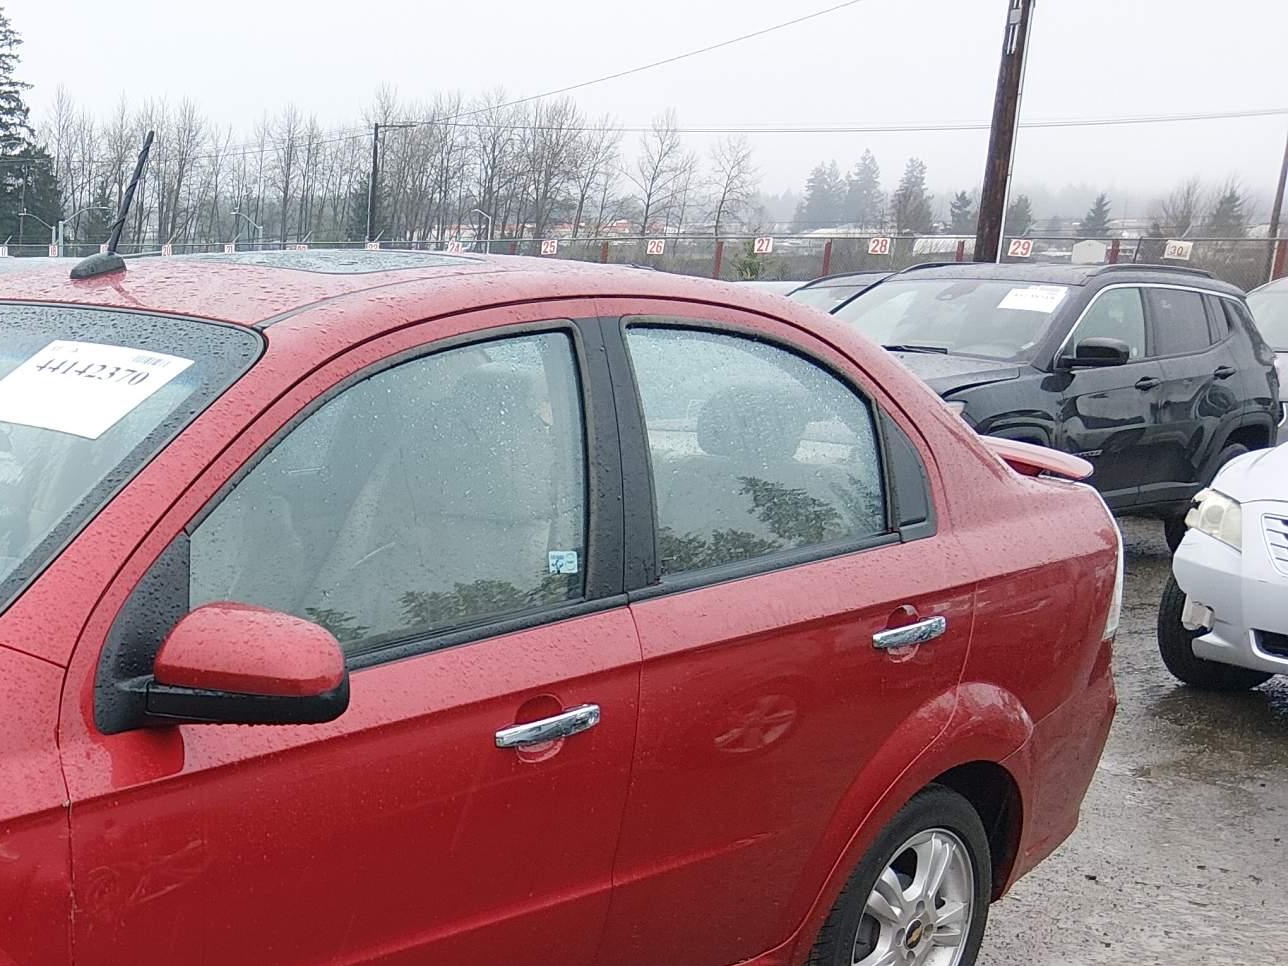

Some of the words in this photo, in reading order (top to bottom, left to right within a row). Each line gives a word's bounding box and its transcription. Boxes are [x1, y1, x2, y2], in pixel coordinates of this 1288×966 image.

[163, 245, 171, 256] 20
[543, 241, 556, 253] 25
[649, 241, 663, 253] 26
[757, 239, 770, 251] 27
[871, 239, 888, 252] 28
[1010, 241, 1030, 255] 29
[35, 358, 150, 386] 44142370
